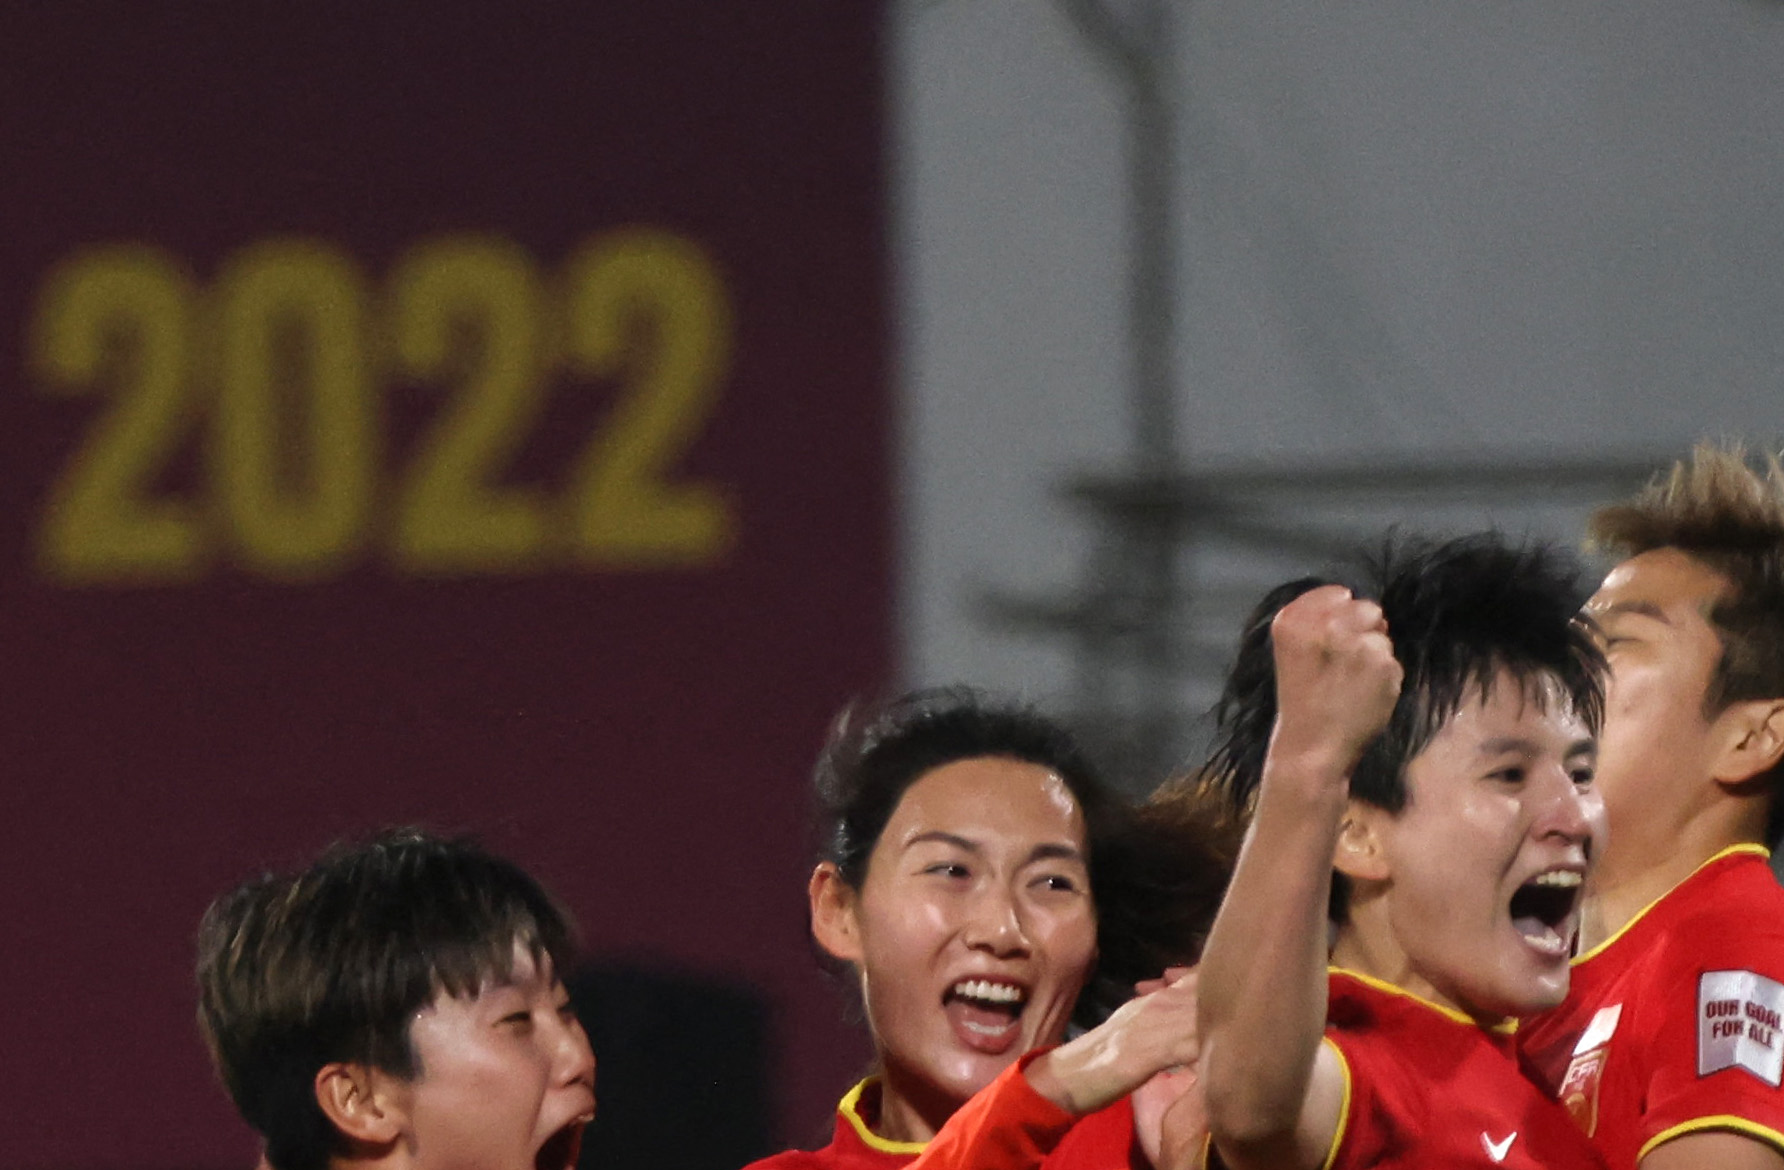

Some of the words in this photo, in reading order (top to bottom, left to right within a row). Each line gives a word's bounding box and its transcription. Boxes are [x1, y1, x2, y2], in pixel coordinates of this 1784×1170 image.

[33, 231, 736, 583] 2022
[1706, 1000, 1740, 1019] OUR
[1745, 1001, 1781, 1032] GOAL
[1712, 1021, 1744, 1039] FOR
[1748, 1023, 1774, 1048] ALL
